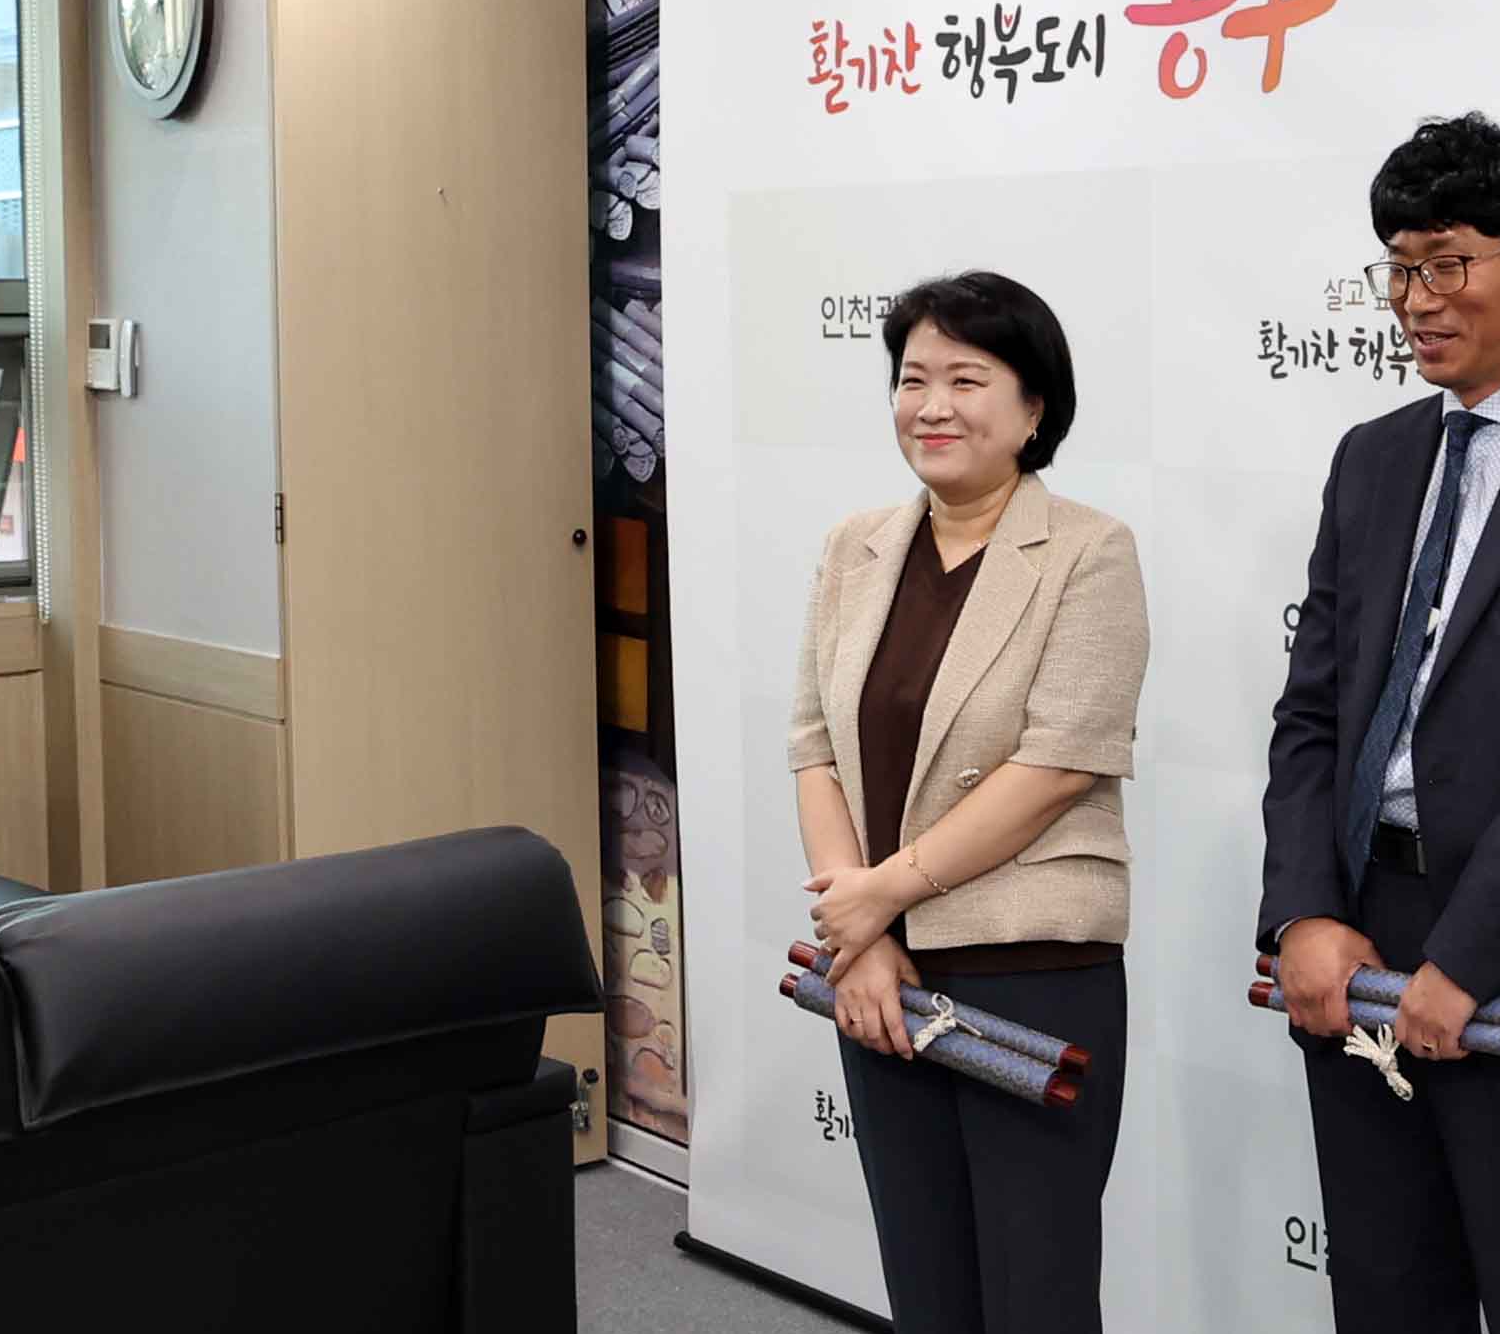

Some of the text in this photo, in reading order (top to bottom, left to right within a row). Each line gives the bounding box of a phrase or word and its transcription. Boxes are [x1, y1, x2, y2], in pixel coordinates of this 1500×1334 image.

[807, 19, 921, 115] 활기찬
[935, 2, 1106, 104] 행복도시
[1323, 278, 1366, 312] 살고
[1257, 318, 1340, 380] 활기찬
[814, 1089, 850, 1141] 활기
